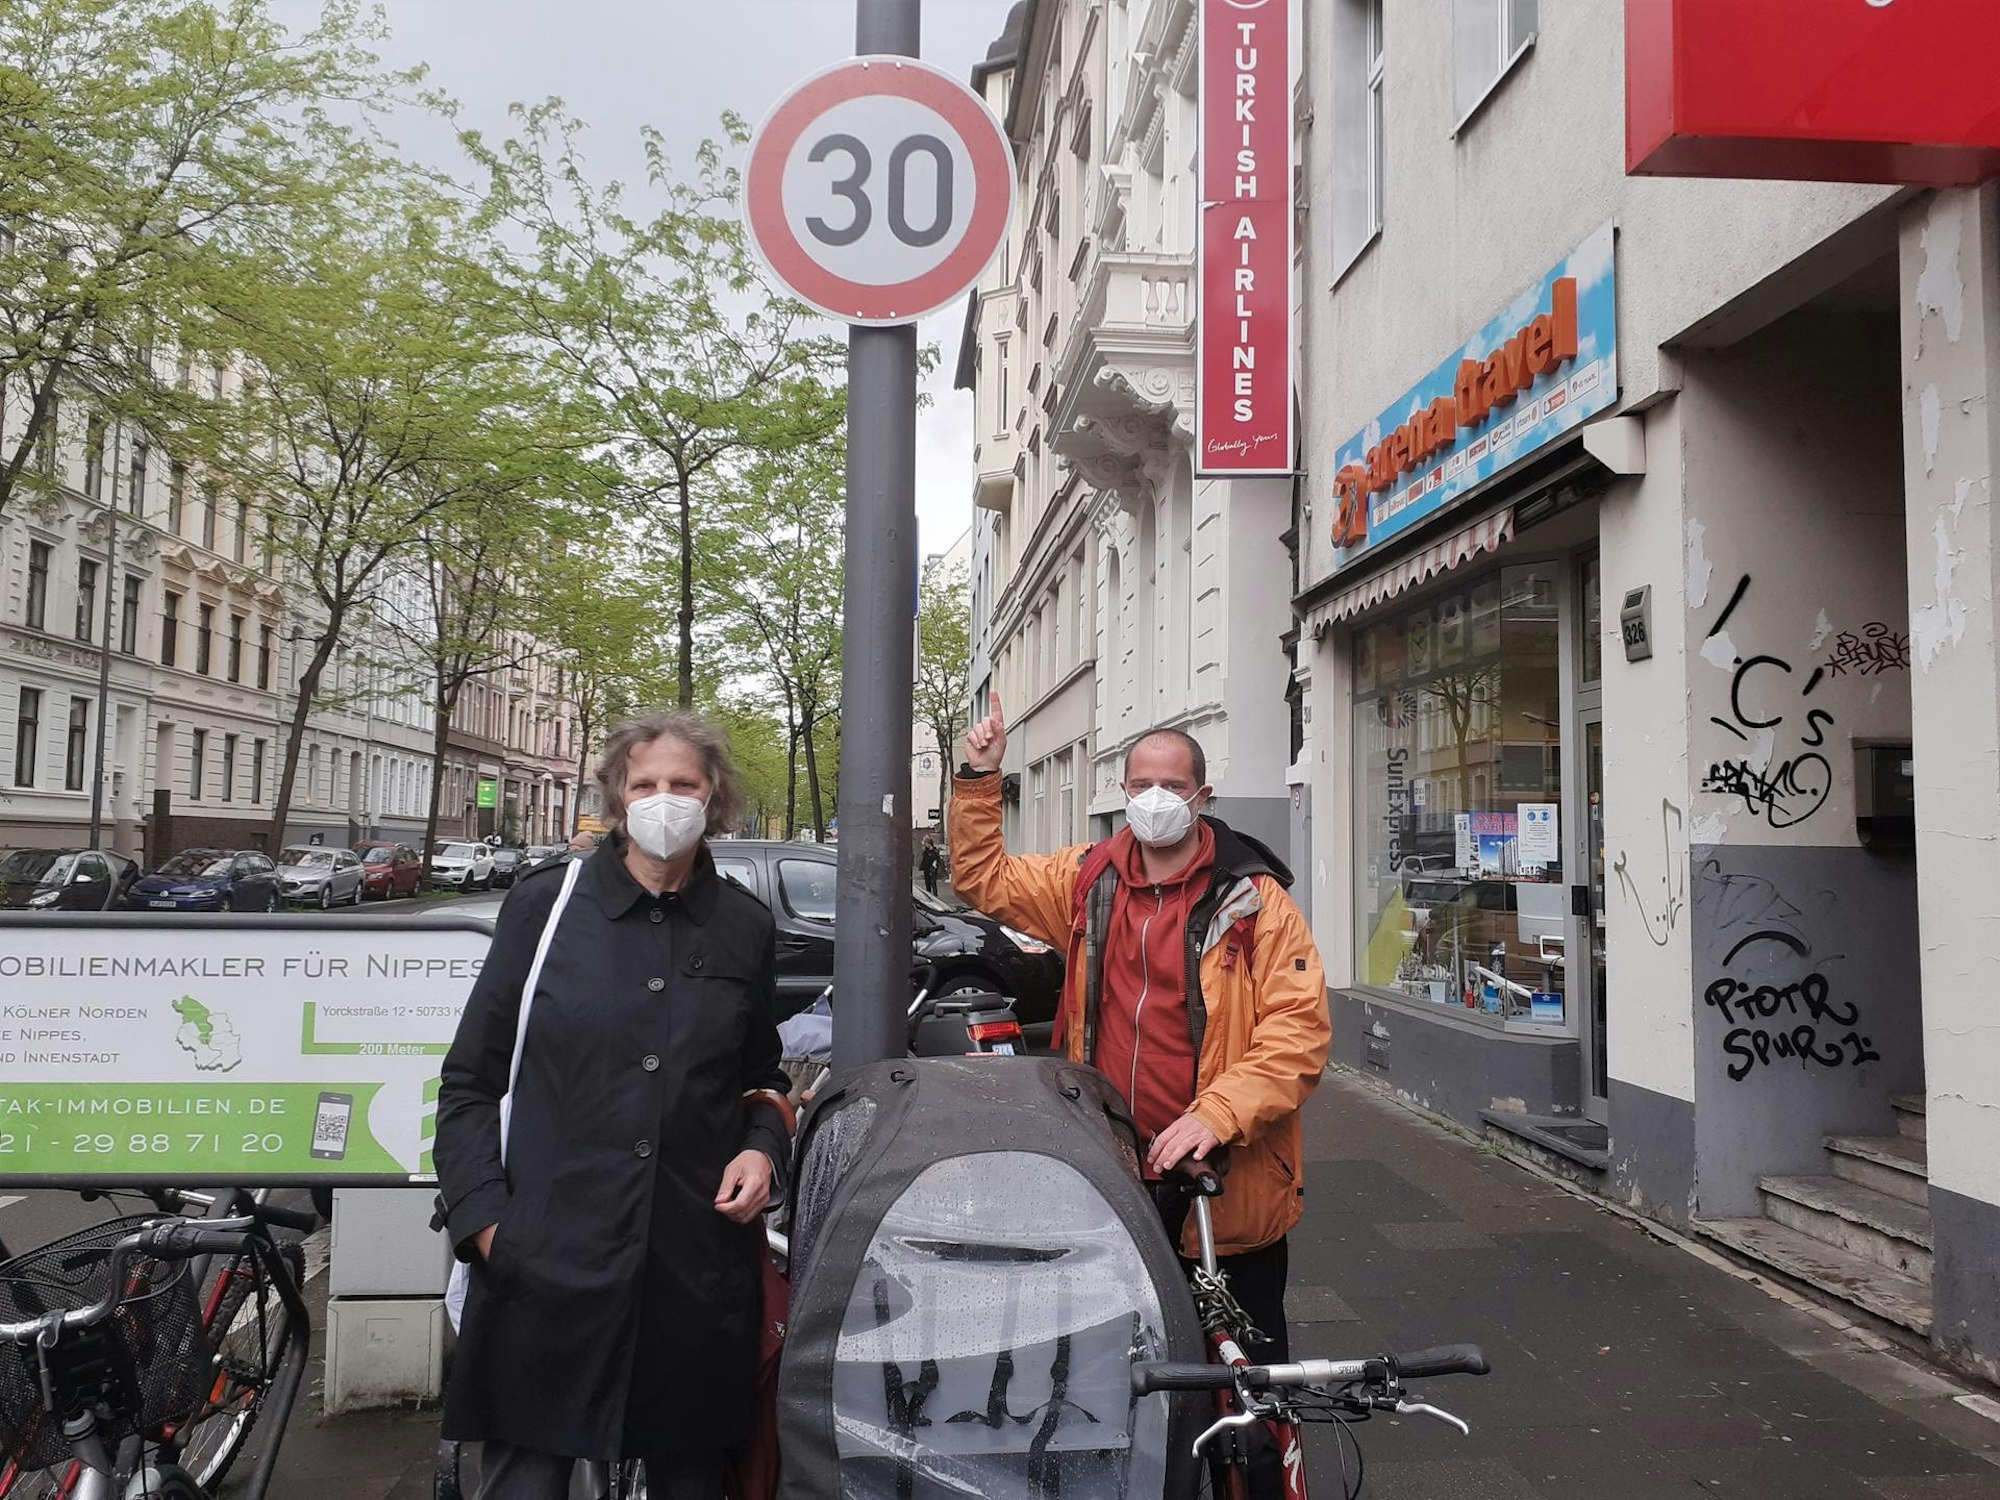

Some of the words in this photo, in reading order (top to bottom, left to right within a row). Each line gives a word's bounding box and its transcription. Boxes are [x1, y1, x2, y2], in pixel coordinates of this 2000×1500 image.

[1235, 22, 1258, 198] TURKISH
[804, 134, 954, 247] 30
[1233, 216, 1257, 422] AIRLINES
[1207, 438, 1252, 457] Globally
[1624, 621, 1645, 646] 326
[1382, 747, 1409, 873] SunExpress
[0, 956, 265, 977] OBILIENMAKLER
[283, 950, 349, 978] FÜR
[3, 1004, 71, 1019] KÖLNER
[78, 1005, 148, 1019] NORDEN
[322, 1005, 389, 1017] Yorckstraße
[393, 1006, 406, 1017] 12
[416, 1006, 451, 1017] 50733
[24, 1050, 120, 1064] INNENSTADT
[359, 1043, 382, 1056] 200
[387, 1043, 426, 1056] Meter
[73, 1133, 115, 1153] 29
[128, 1133, 170, 1153] 88
[186, 1133, 219, 1153] 71
[241, 1133, 284, 1153] 20
